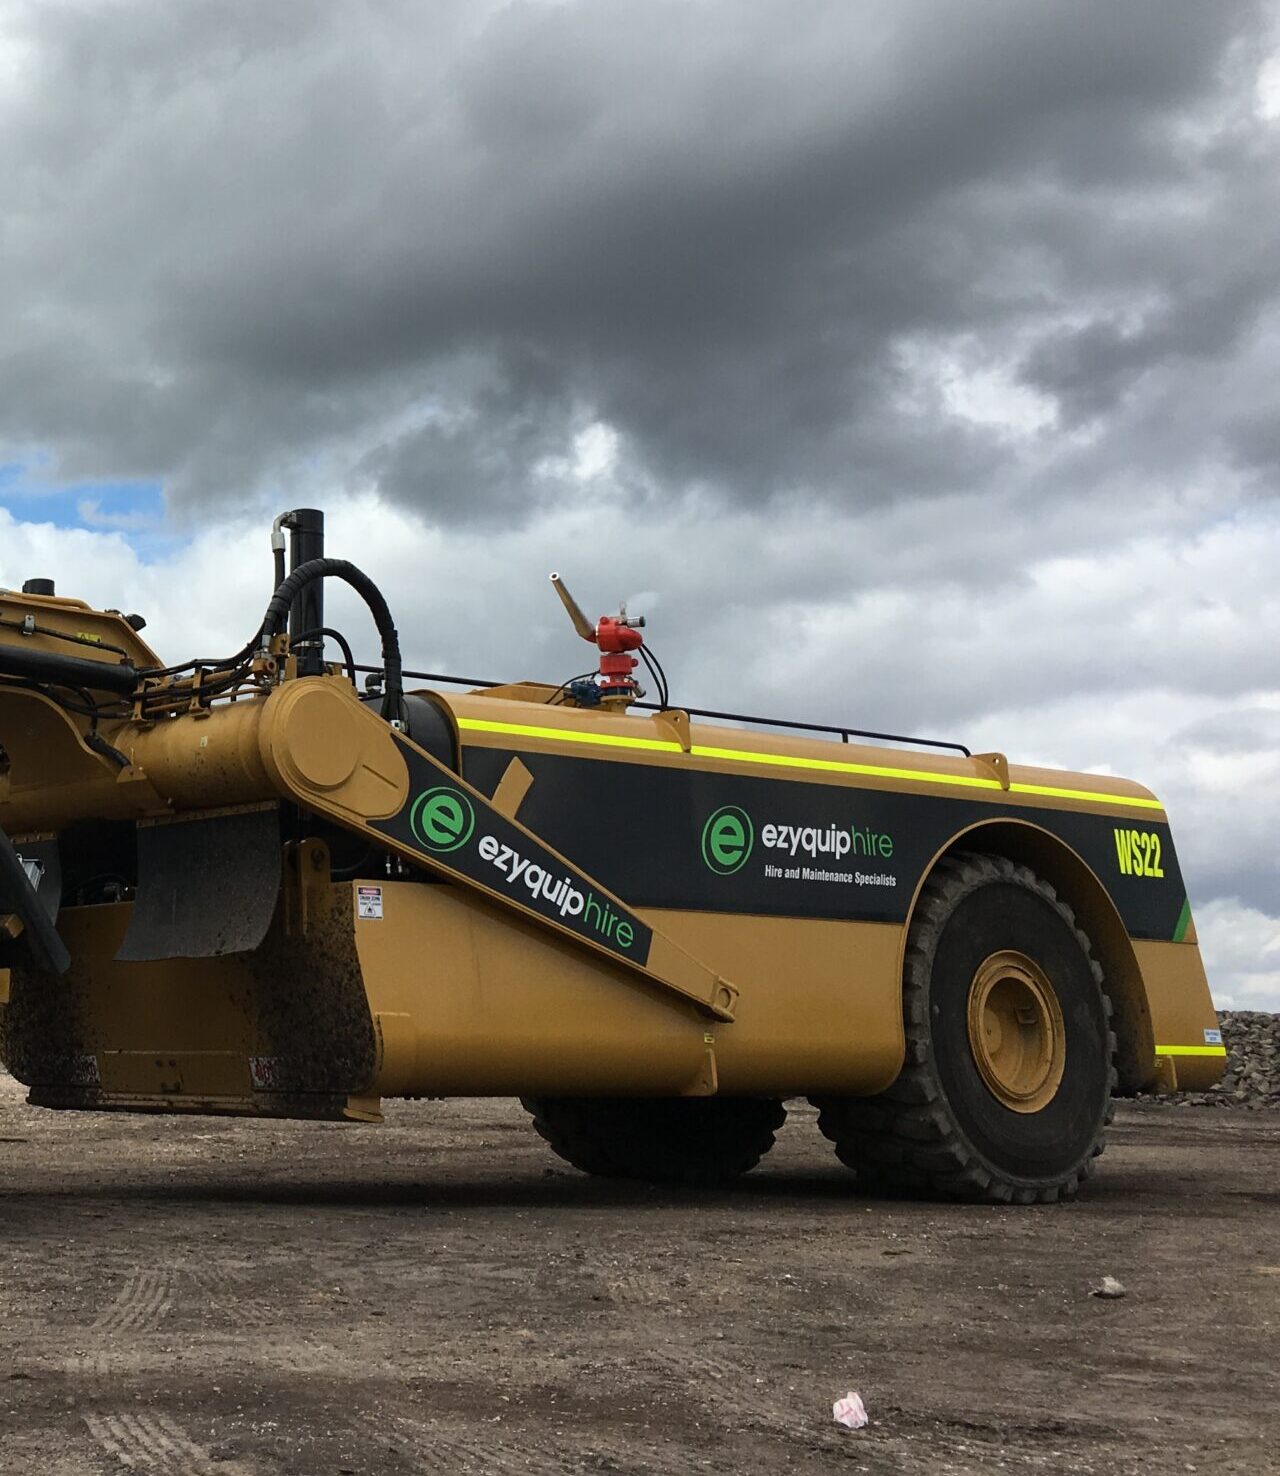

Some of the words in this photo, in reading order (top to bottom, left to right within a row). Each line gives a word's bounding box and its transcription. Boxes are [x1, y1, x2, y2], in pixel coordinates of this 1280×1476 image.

[761, 823, 894, 860] ezyquiphire
[1113, 828, 1164, 878] WS22
[478, 835, 634, 948] ezyquiphire
[765, 865, 783, 878] Hire
[784, 867, 800, 879] and
[802, 867, 853, 883] Maintenance
[855, 872, 896, 887] Specialists
